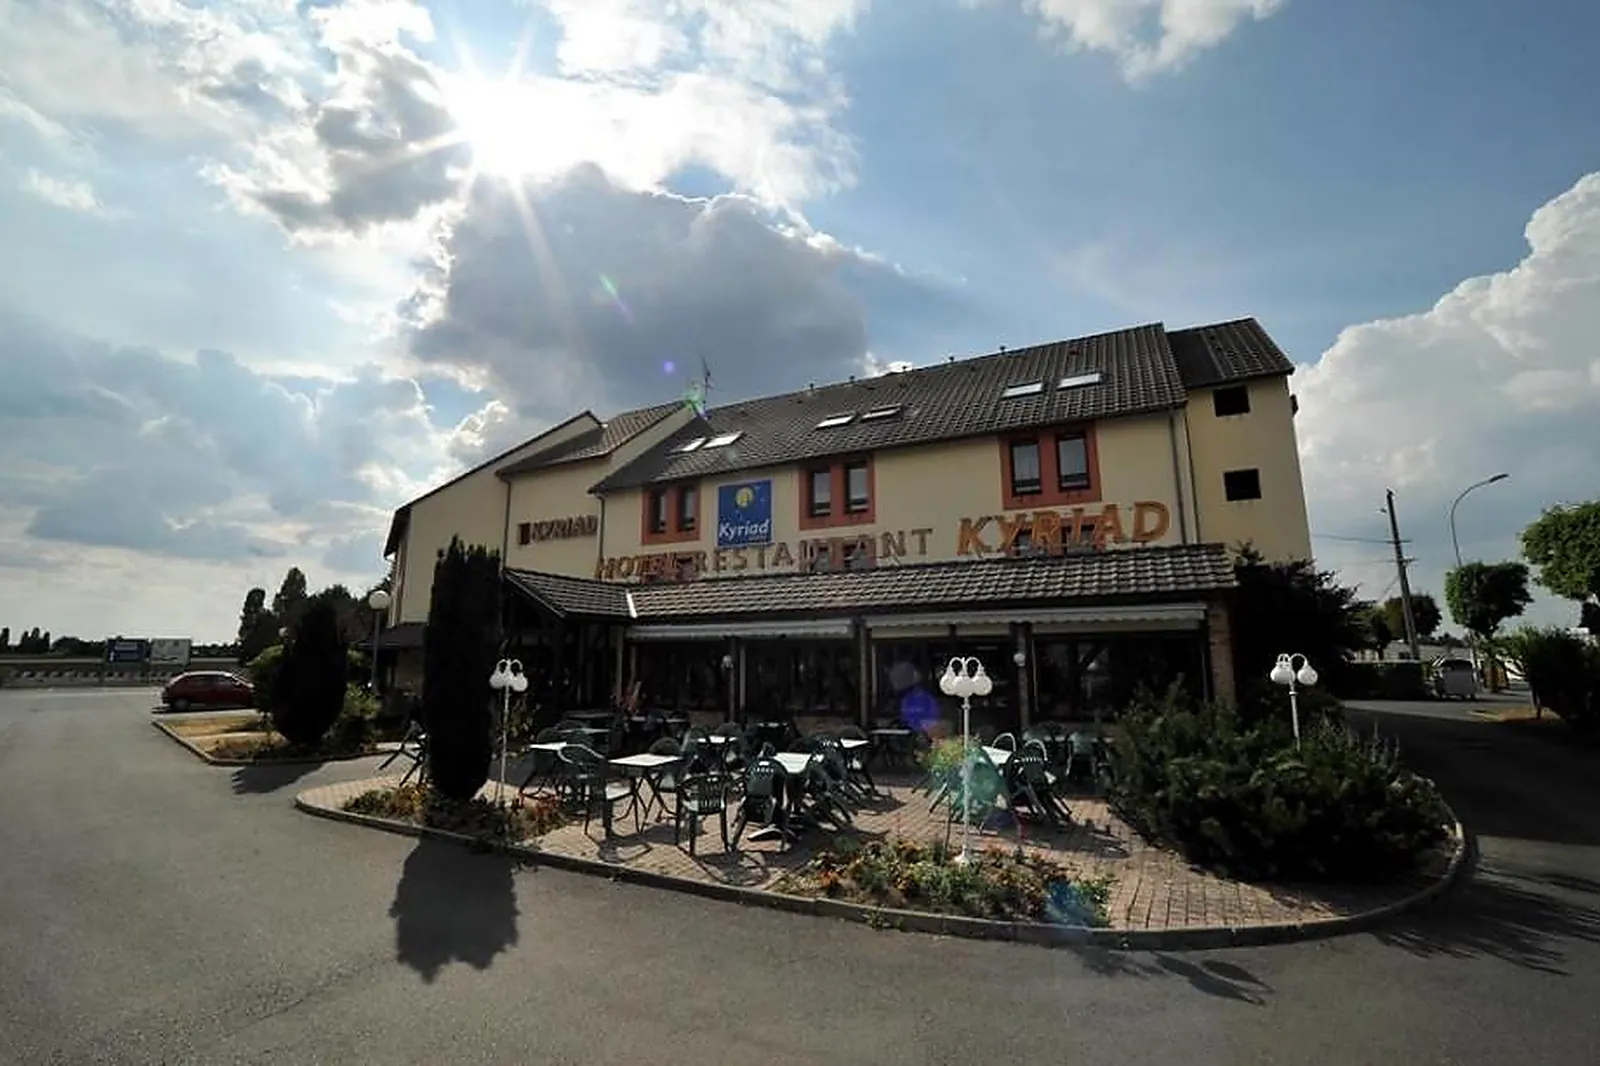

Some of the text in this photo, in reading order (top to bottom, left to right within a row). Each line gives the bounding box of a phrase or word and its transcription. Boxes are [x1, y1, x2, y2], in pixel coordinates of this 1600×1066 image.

[692, 528, 933, 574] RESTAURANT
[957, 500, 1169, 557] KYRIAD
[718, 518, 770, 541] Kyriad
